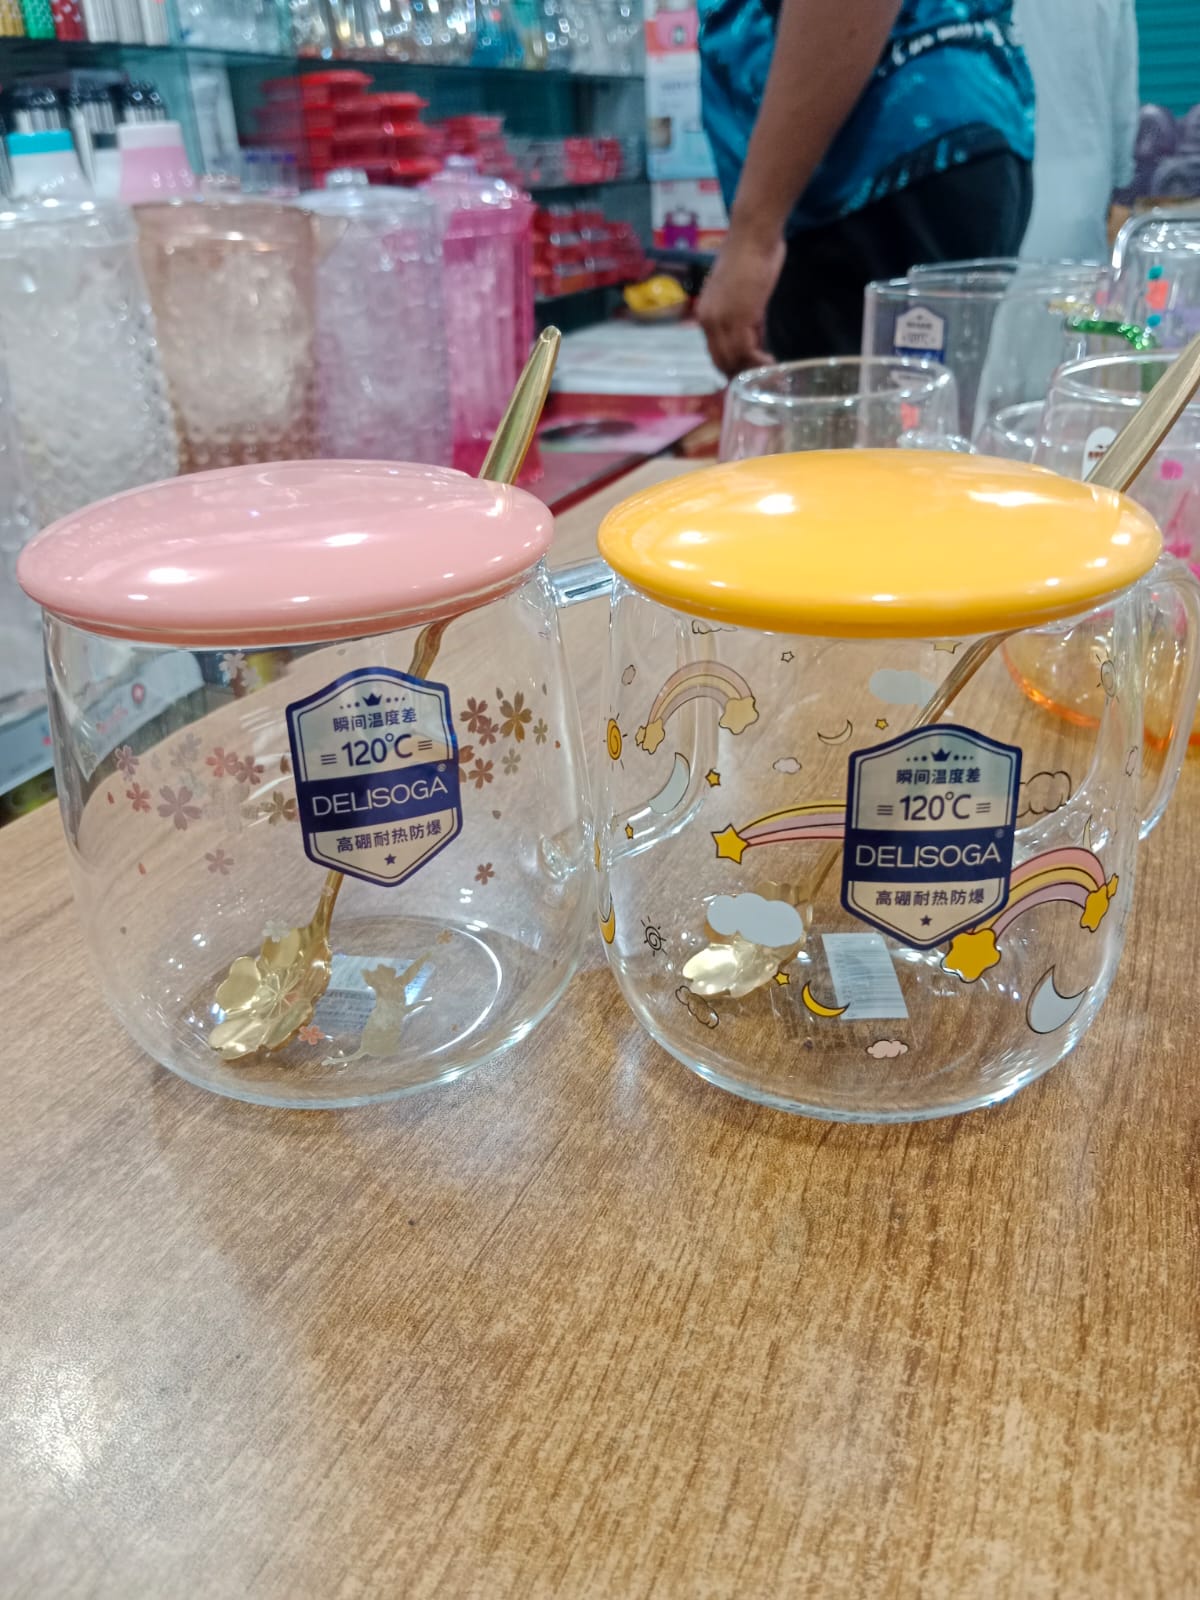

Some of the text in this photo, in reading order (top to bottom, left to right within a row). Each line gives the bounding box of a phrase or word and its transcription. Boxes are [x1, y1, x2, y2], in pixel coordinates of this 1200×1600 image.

[333, 707, 417, 732] 瞬间温度差
[896, 767, 981, 785] 瞬间温度差
[312, 776, 449, 817] DELISOGA
[336, 819, 442, 853] 高硼耐热防爆
[855, 842, 1001, 868] DELISOGA
[875, 888, 985, 907] 高硼耐热防爆
